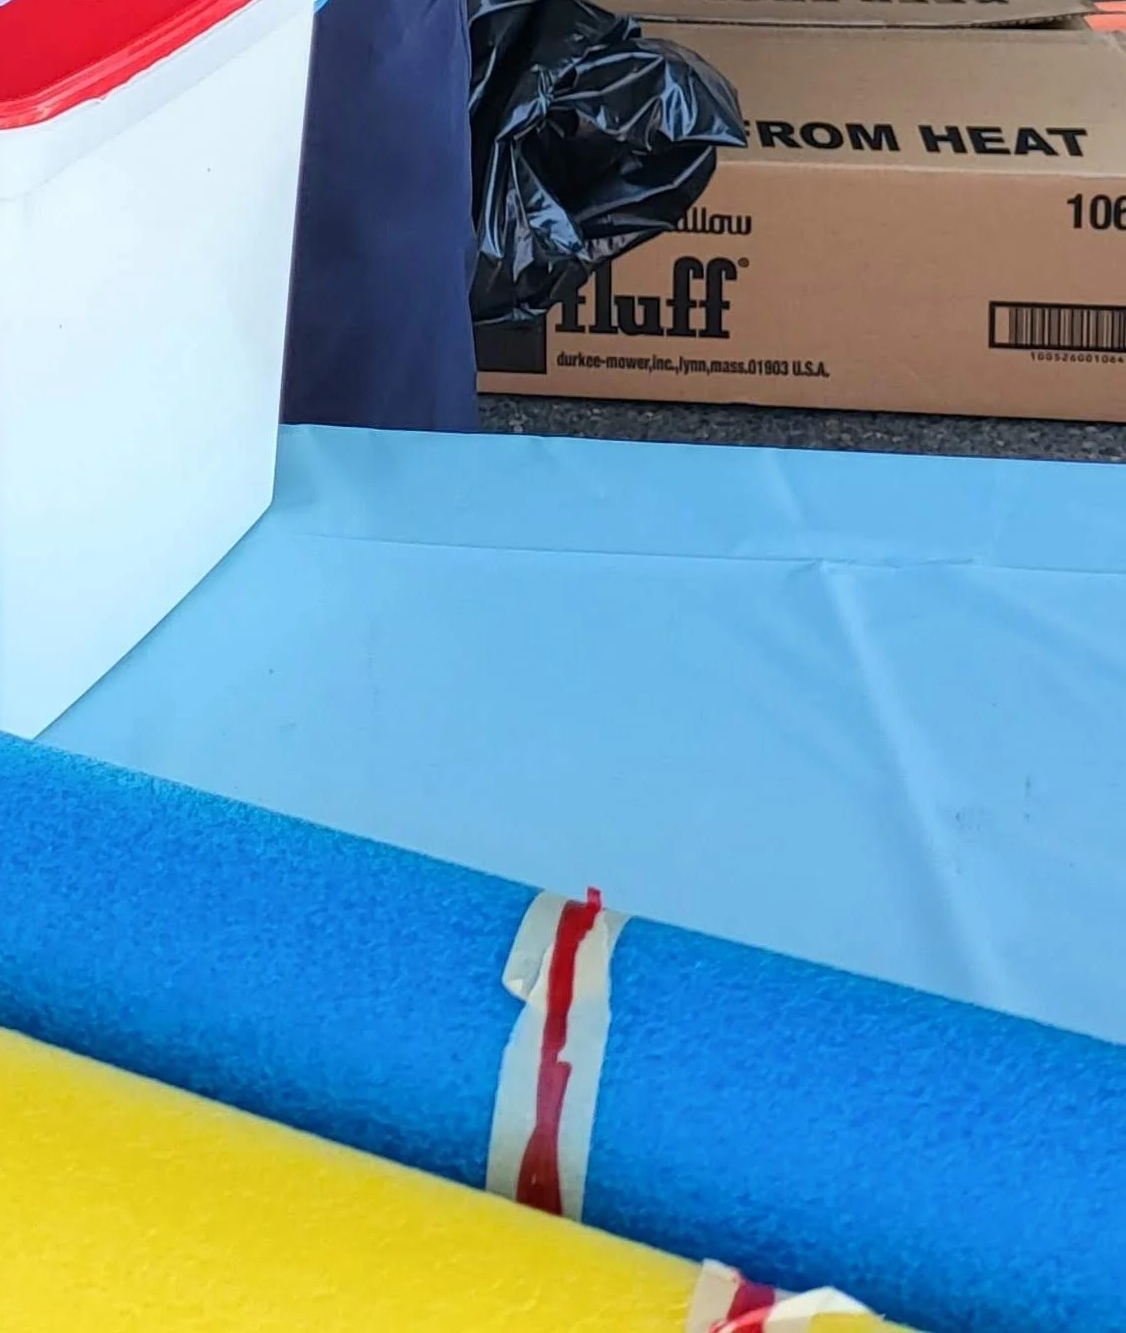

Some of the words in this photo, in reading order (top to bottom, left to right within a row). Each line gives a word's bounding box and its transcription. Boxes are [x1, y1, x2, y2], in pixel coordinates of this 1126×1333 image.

[743, 119, 901, 153] ROM
[918, 123, 1089, 157] HEAT
[555, 256, 737, 339] fluff
[792, 360, 830, 378] U.S.A.
